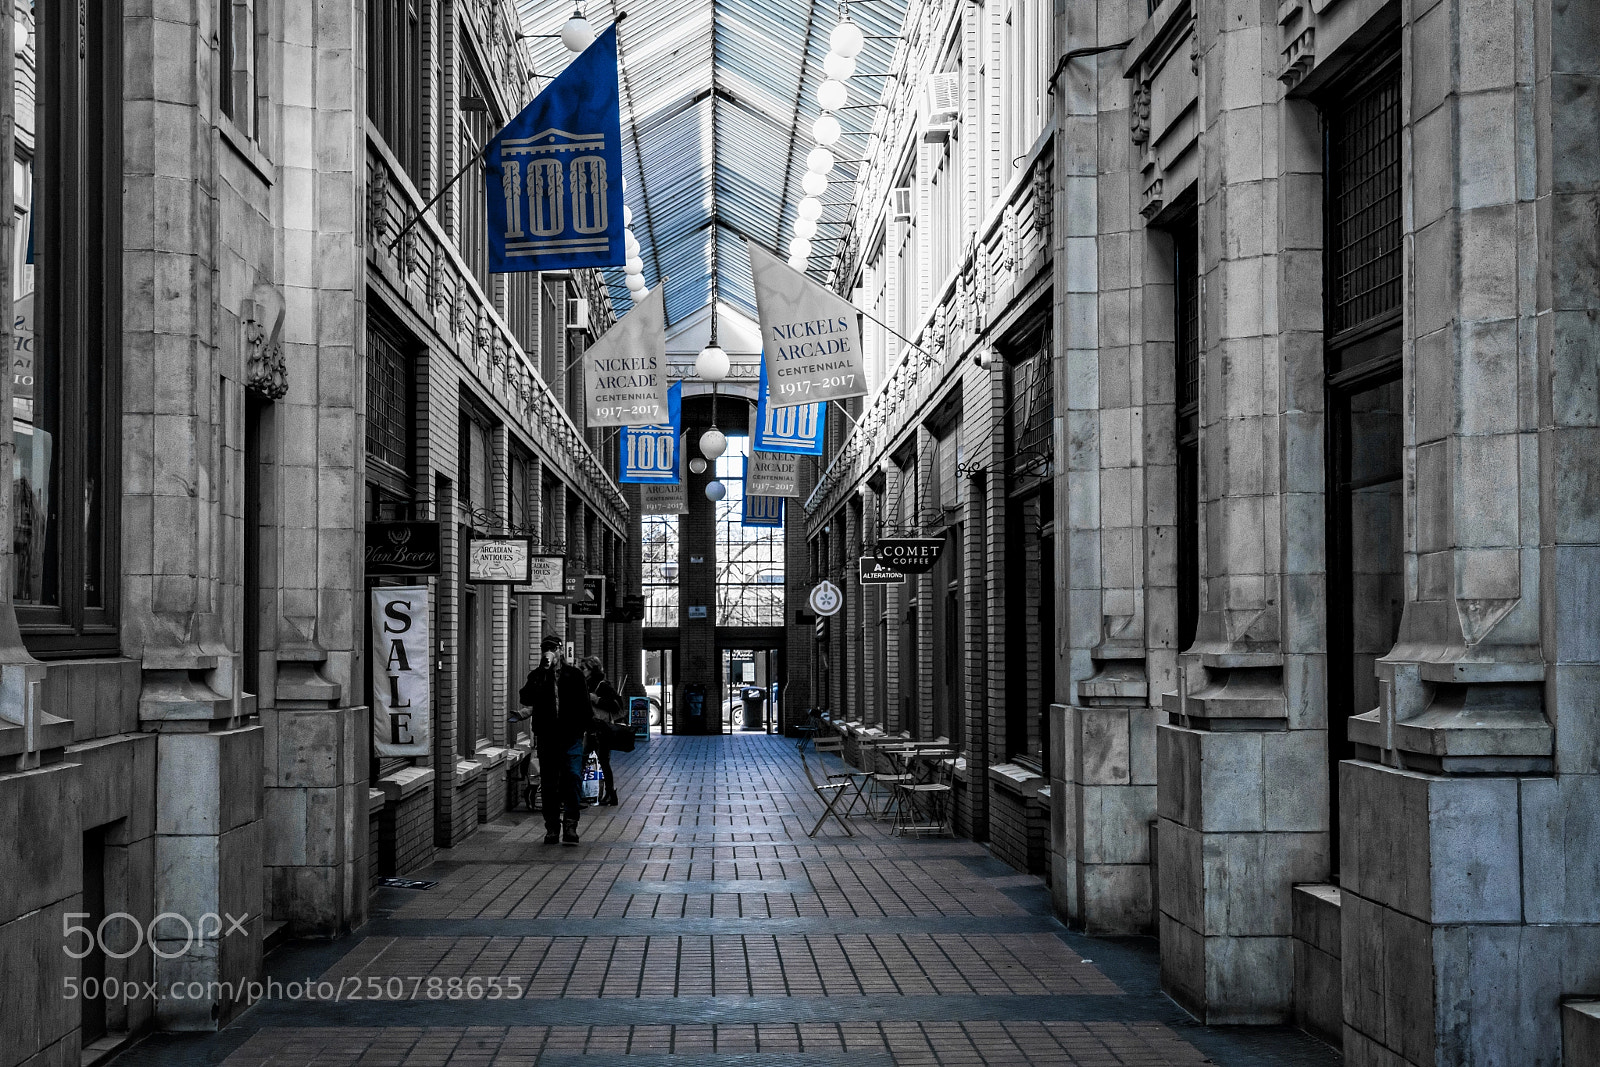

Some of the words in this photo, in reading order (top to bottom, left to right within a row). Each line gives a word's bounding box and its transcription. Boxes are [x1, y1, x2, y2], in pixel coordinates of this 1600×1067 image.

[502, 156, 608, 238] 100
[772, 317, 848, 341] NICKELS
[776, 337, 851, 361] ARCADE
[594, 357, 657, 372] NICKELS
[777, 360, 853, 377] CENTENNIAL
[594, 374, 658, 389] ARCADE
[780, 374, 855, 396] 1917–2017
[596, 393, 659, 402] CENTENNIAL
[596, 405, 659, 418] 1917–2017
[763, 397, 819, 439] 100
[626, 434, 674, 470] 100
[754, 451, 796, 461] NICKELS
[753, 463, 795, 472] ARCADE
[645, 485, 683, 494] ARCADE
[746, 495, 779, 518] 100
[883, 546, 940, 557] COMET
[384, 600, 414, 744] SALE
